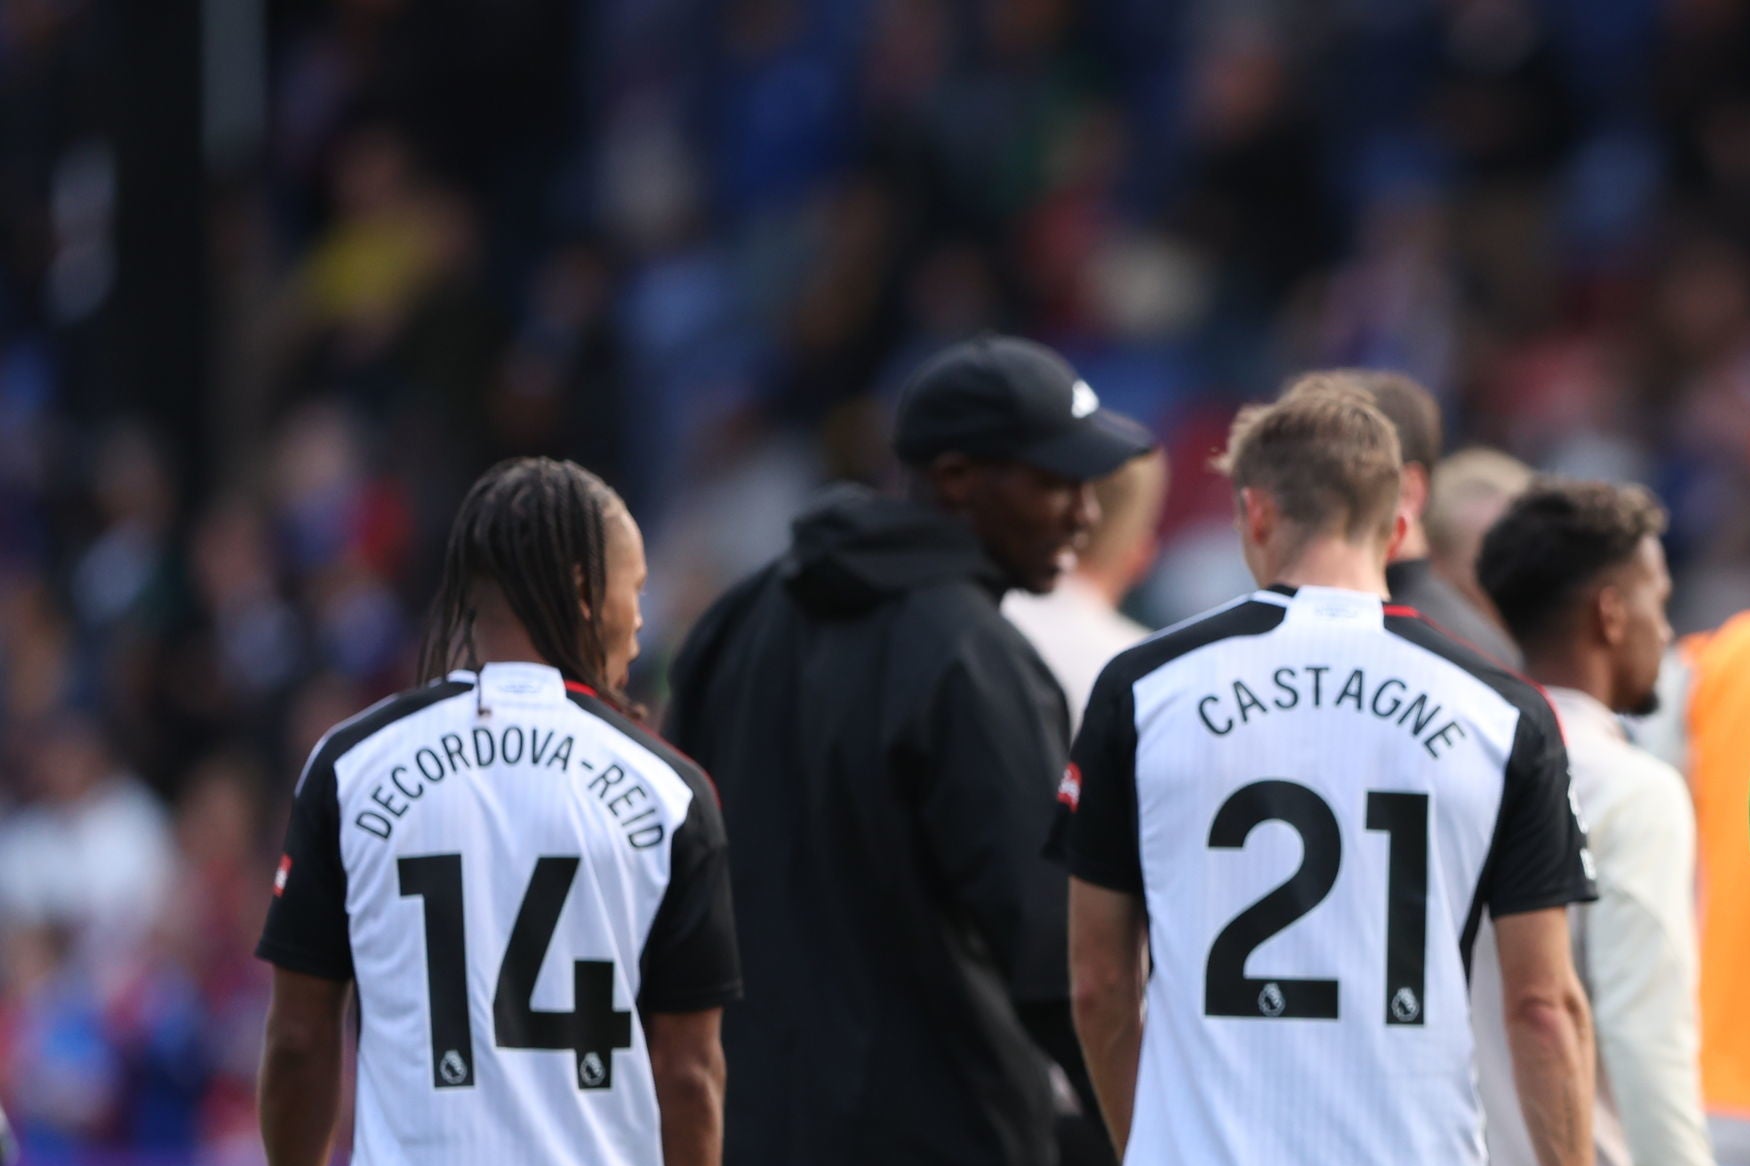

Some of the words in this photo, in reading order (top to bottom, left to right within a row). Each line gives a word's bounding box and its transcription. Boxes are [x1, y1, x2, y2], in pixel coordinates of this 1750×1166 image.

[355, 725, 666, 851] DECORDOVA-REID
[1197, 665, 1467, 760] CASTAGNE
[397, 853, 632, 1089] 14
[1204, 779, 1430, 1026] 21
